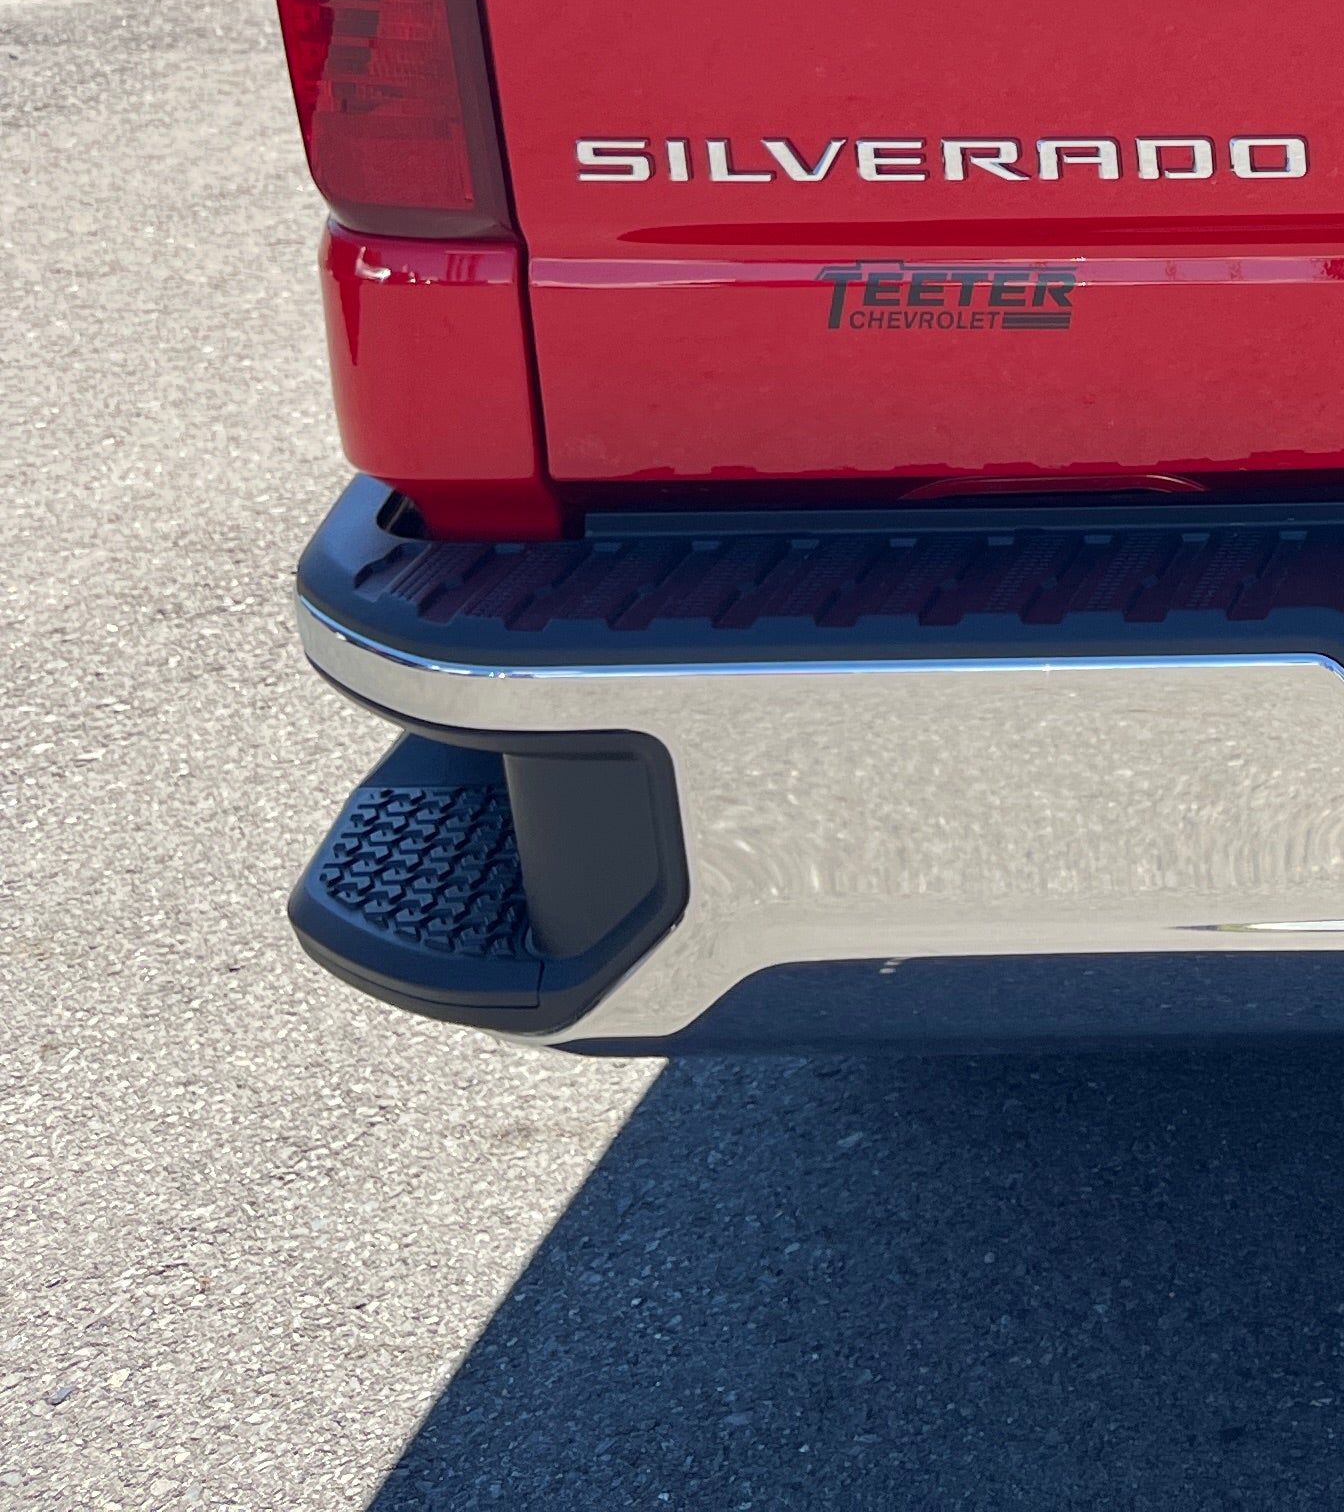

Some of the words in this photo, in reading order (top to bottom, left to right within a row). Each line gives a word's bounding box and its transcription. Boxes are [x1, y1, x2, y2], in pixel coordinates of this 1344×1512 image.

[576, 135, 1309, 182] SILVERADO
[820, 272, 1076, 329] TEETER
[850, 310, 999, 329] CHEVROLET
